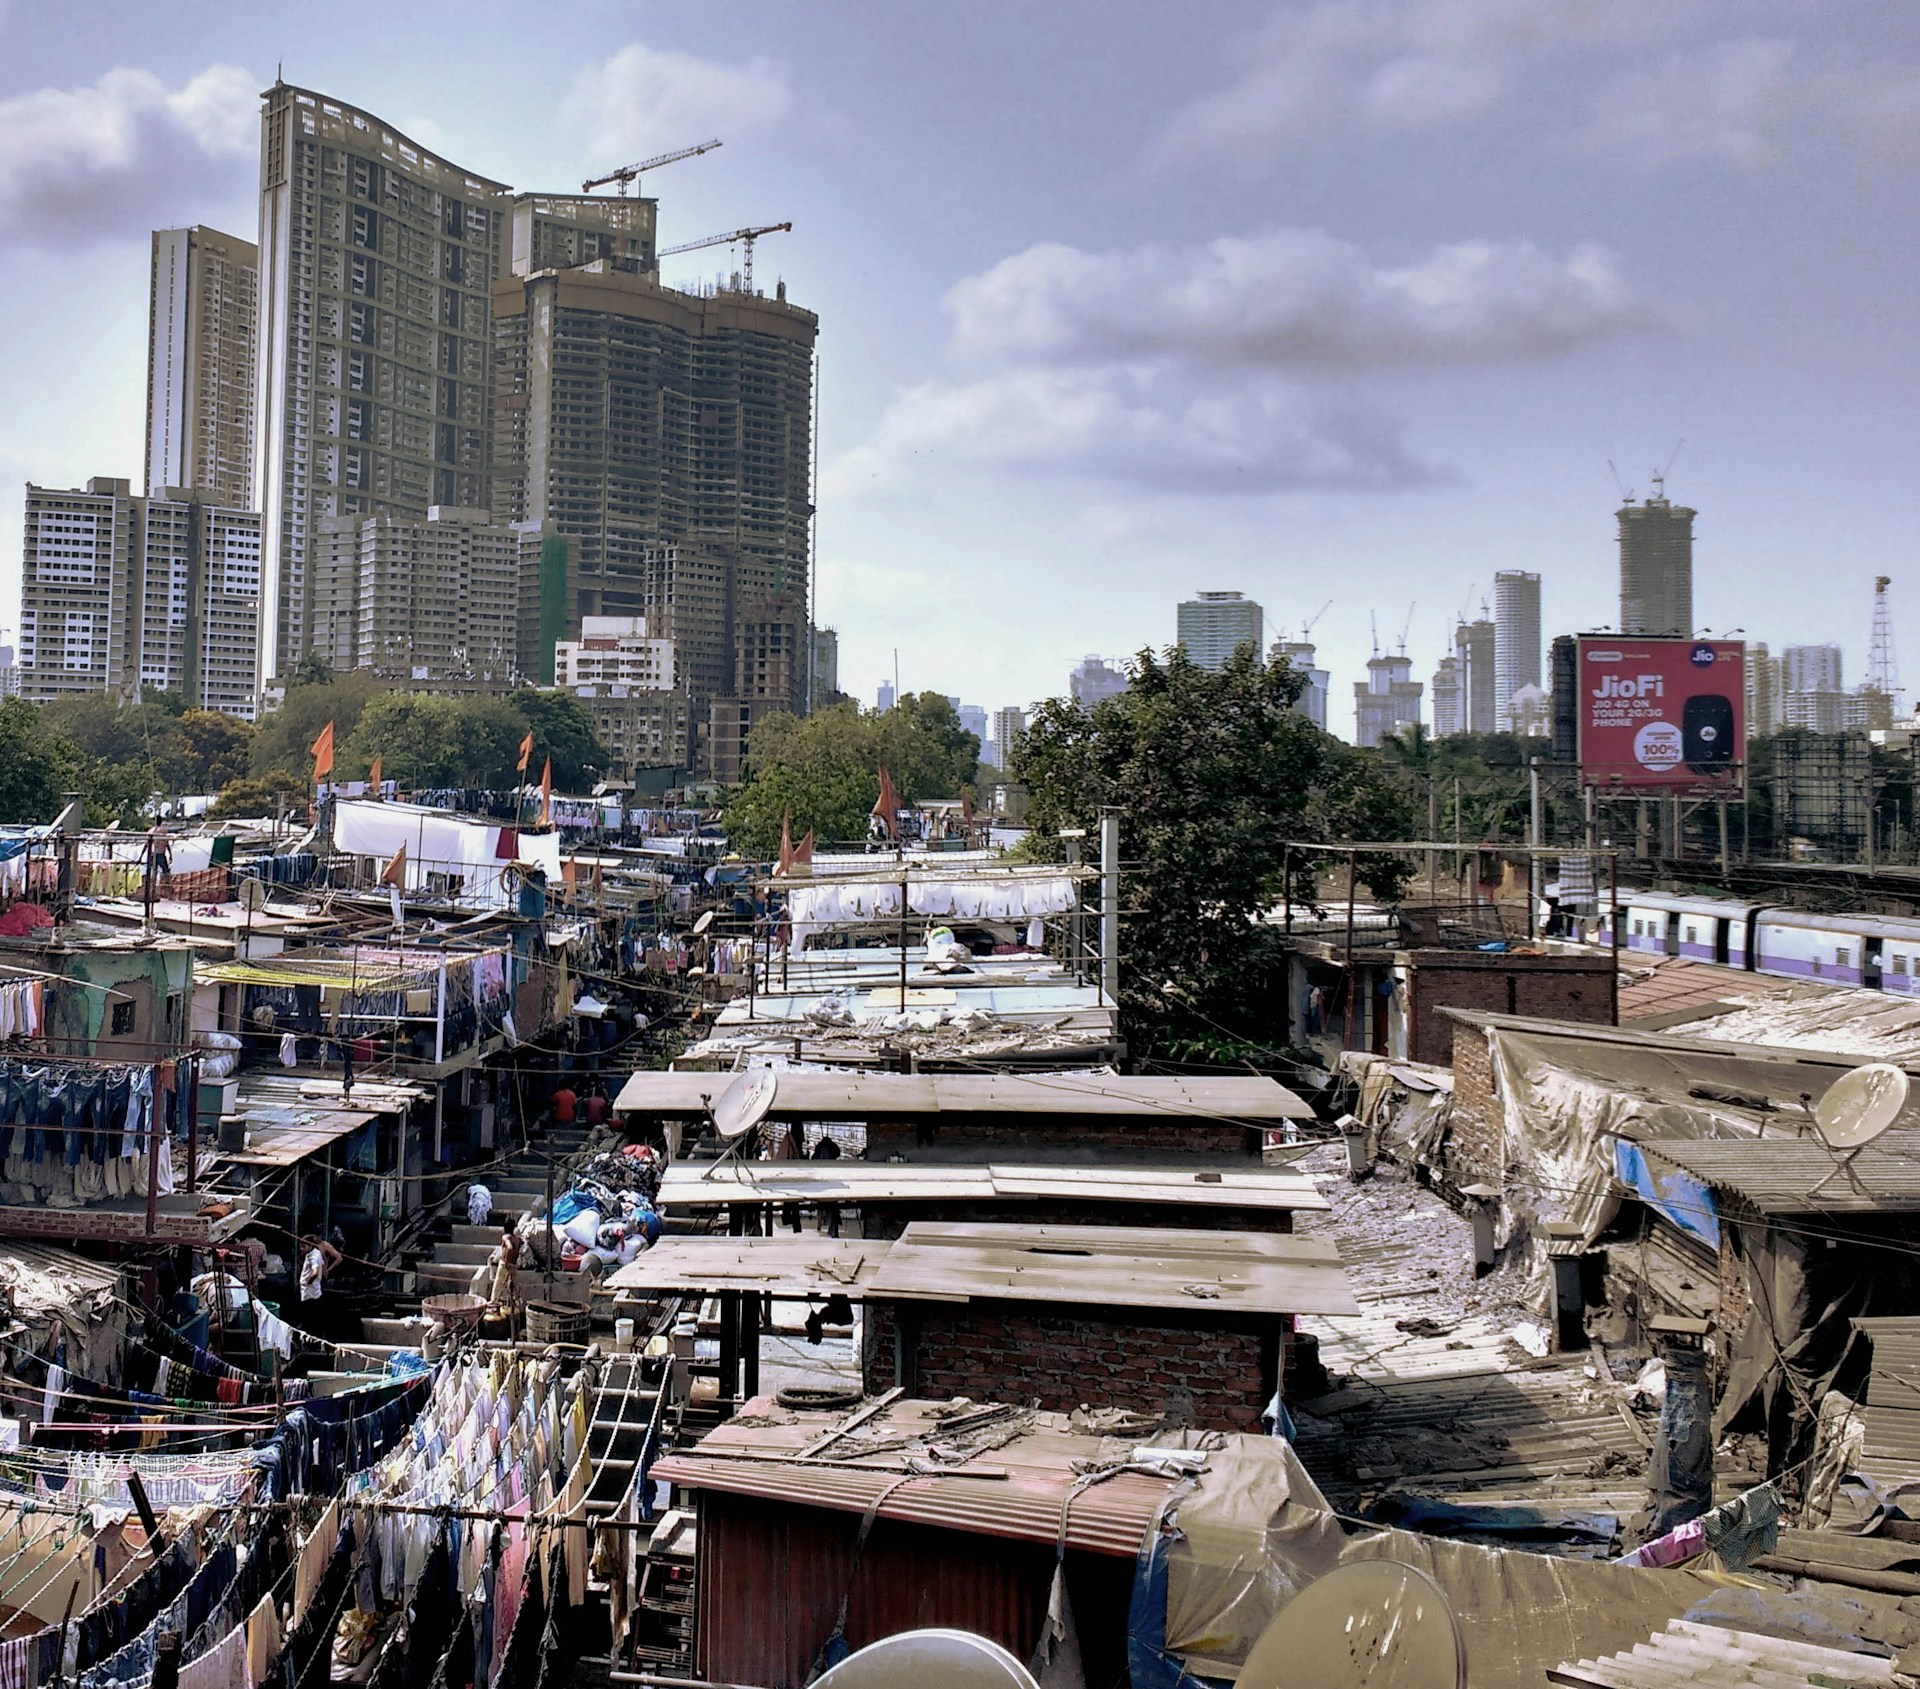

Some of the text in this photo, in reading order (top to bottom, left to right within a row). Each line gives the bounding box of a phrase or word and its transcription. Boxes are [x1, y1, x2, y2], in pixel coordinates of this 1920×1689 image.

[1692, 650, 1714, 662] Jio
[1592, 675, 1664, 698] JioFi
[1592, 700, 1650, 709] JIO 4G ON
[1592, 709, 1663, 717] YOUR 2G/3G
[1592, 718, 1632, 727] PHONE
[1643, 744, 1680, 755] 100%
